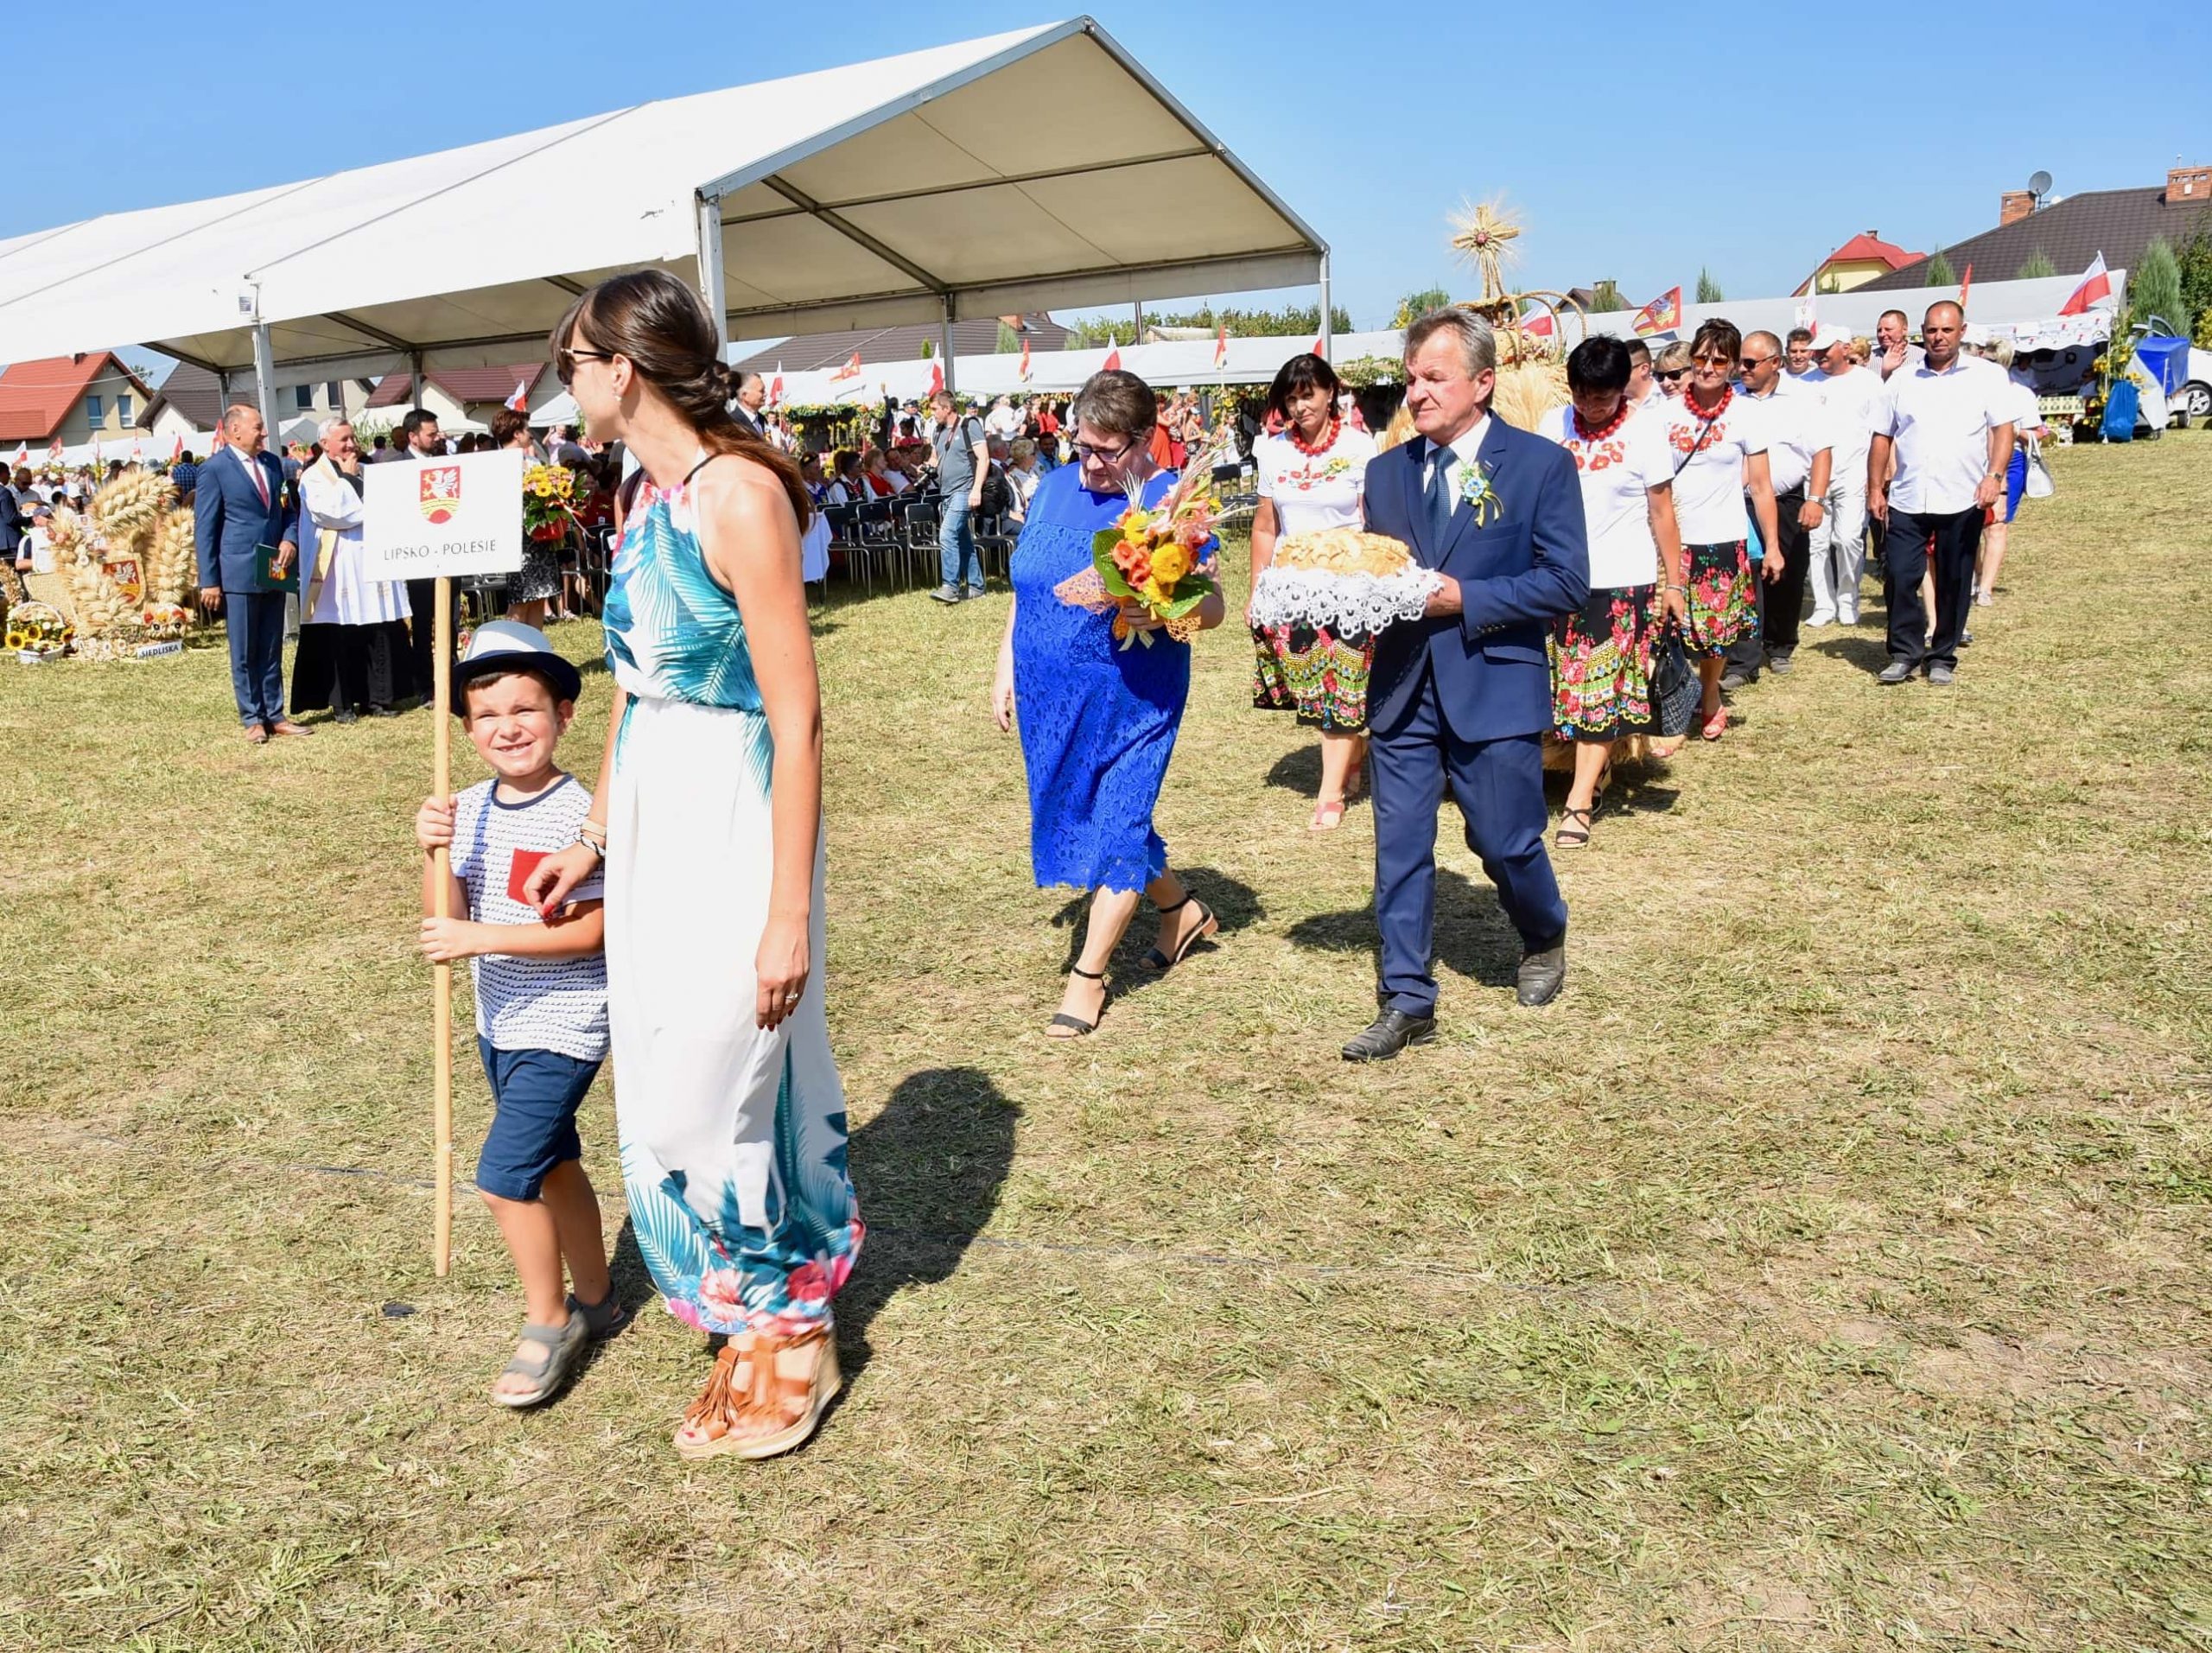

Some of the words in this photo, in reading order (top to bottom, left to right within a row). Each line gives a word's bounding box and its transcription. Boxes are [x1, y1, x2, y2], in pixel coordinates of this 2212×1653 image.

[384, 544, 430, 561] LIPSKO
[442, 539, 496, 556] POLESIE
[141, 644, 179, 658] SIEDLISKA
